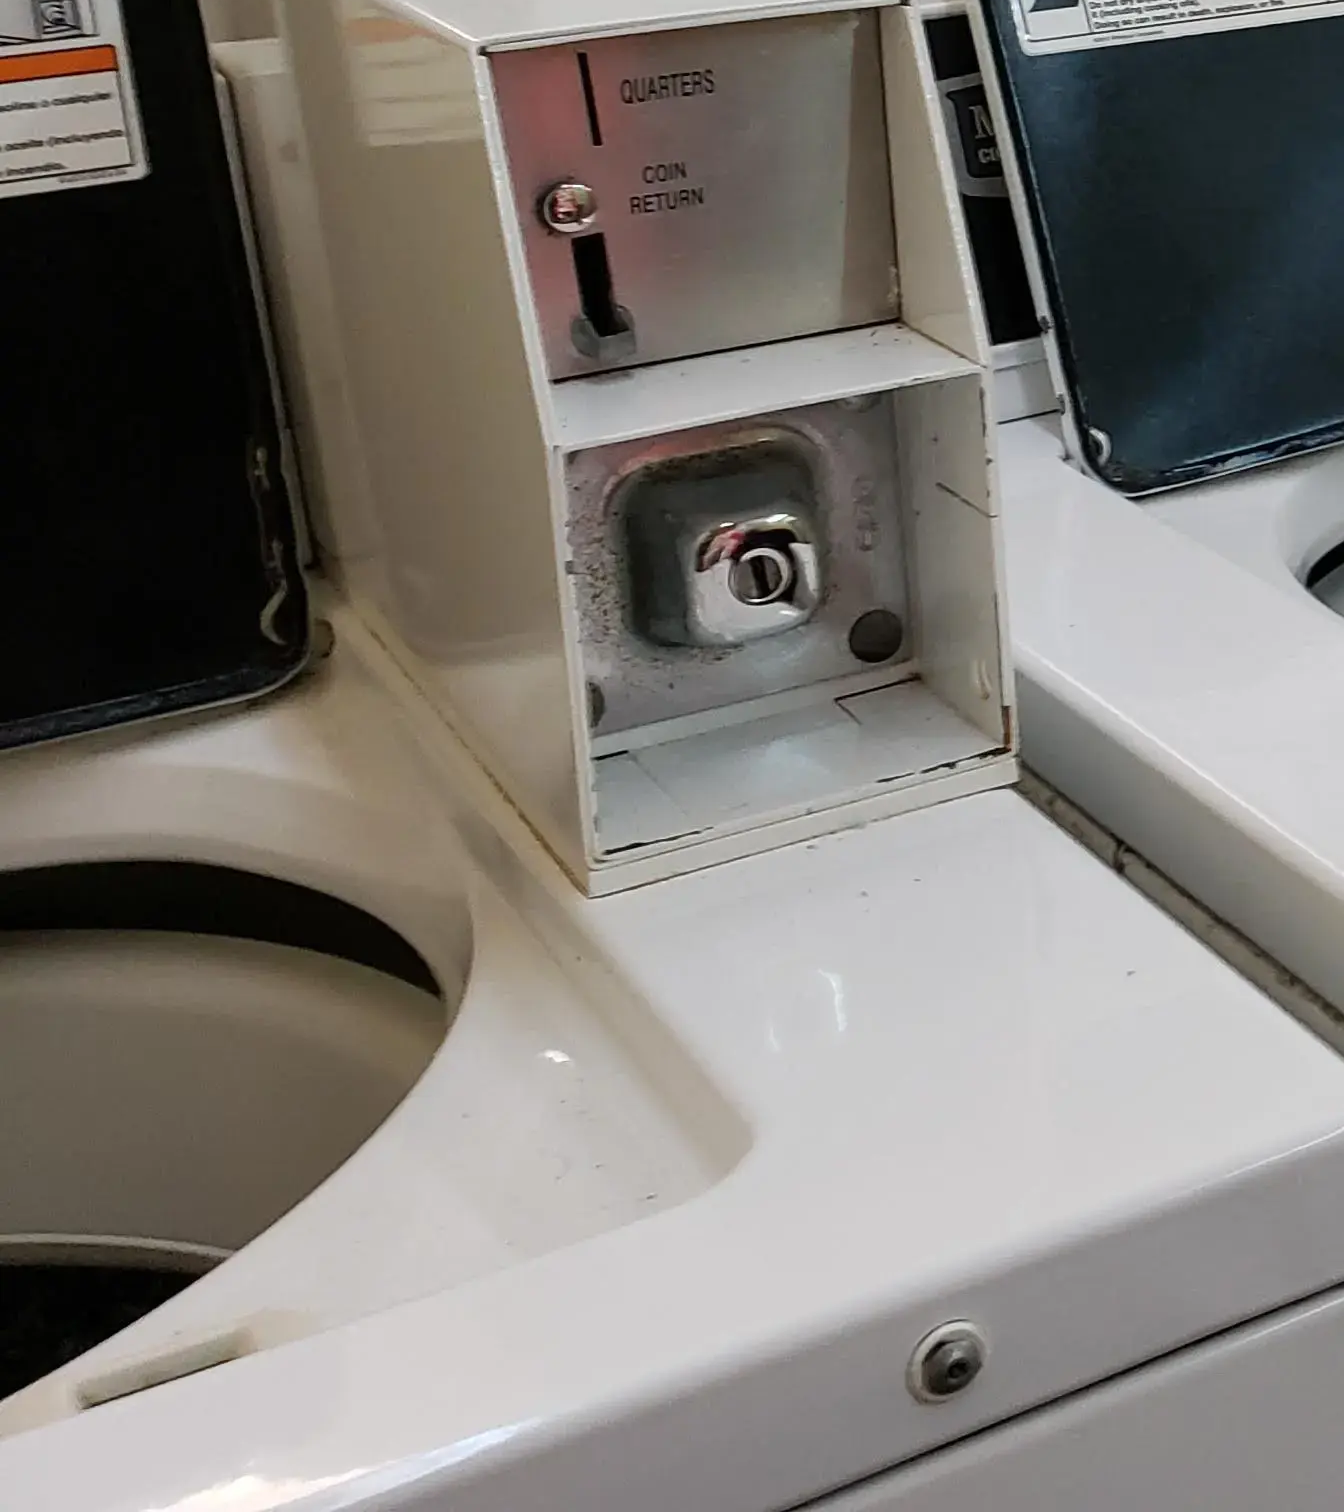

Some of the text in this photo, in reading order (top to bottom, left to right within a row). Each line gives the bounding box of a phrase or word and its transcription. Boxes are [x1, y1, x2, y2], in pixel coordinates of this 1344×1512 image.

[620, 69, 715, 104] QUARTERS
[643, 162, 688, 184] COIN
[630, 188, 704, 215] RETURN
